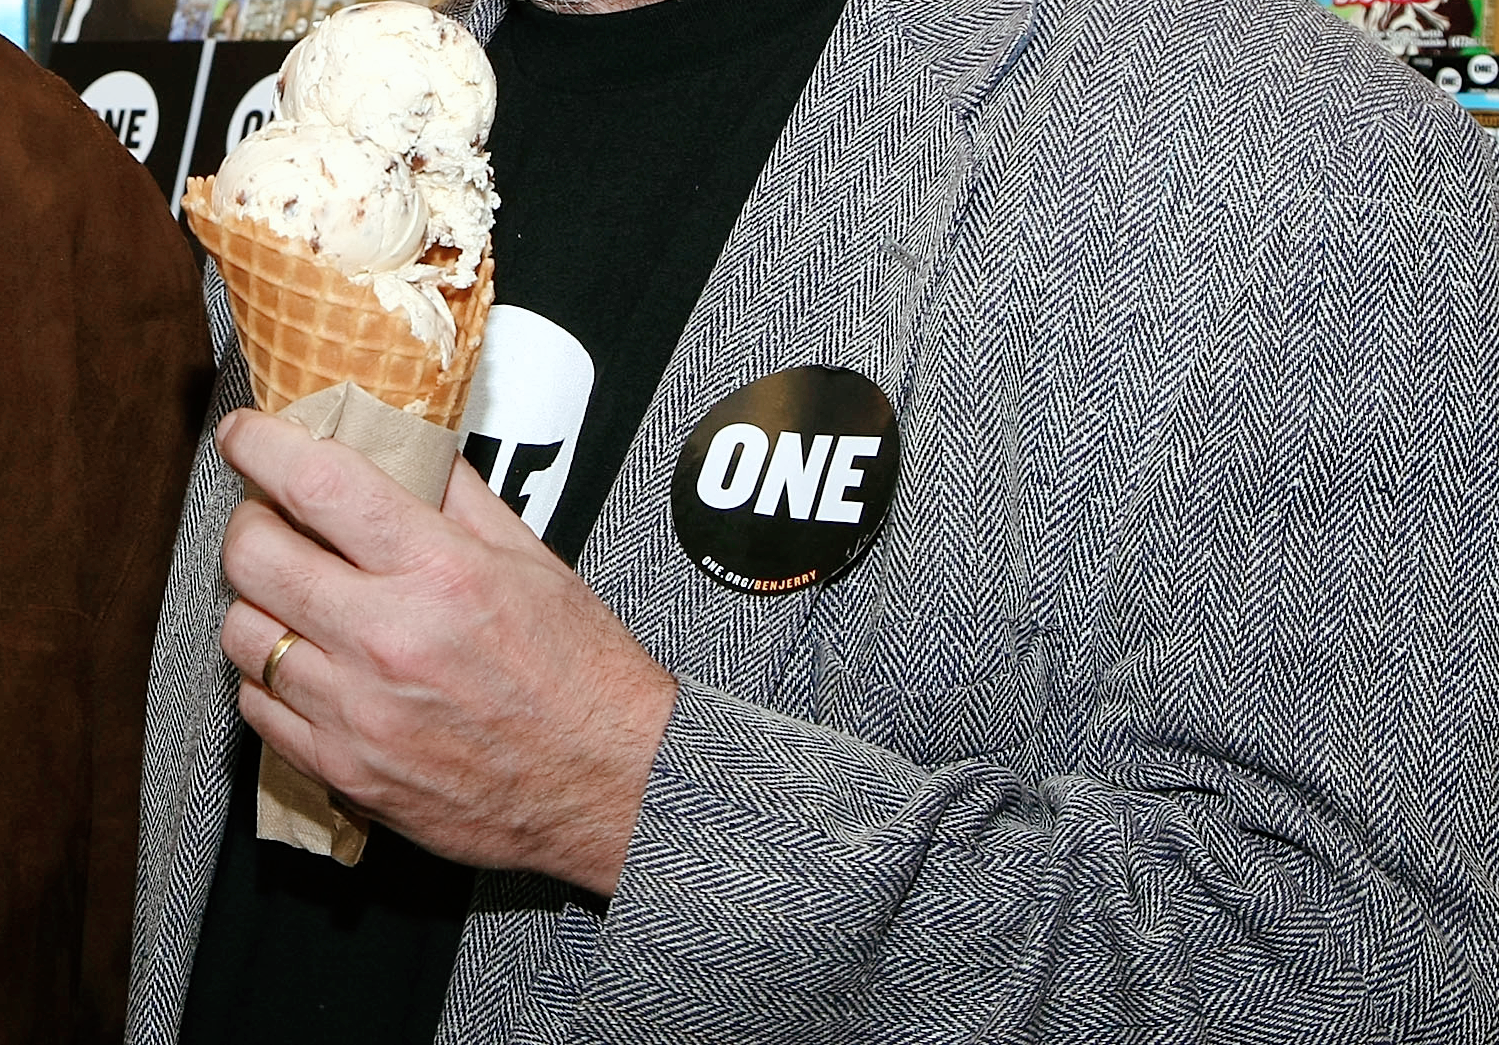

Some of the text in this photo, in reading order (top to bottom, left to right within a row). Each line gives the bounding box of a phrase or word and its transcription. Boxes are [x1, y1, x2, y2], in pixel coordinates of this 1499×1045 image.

[93, 109, 147, 149] NE
[697, 422, 883, 525] ONE
[701, 555, 817, 592] ONE.ORG/BENJERRY
